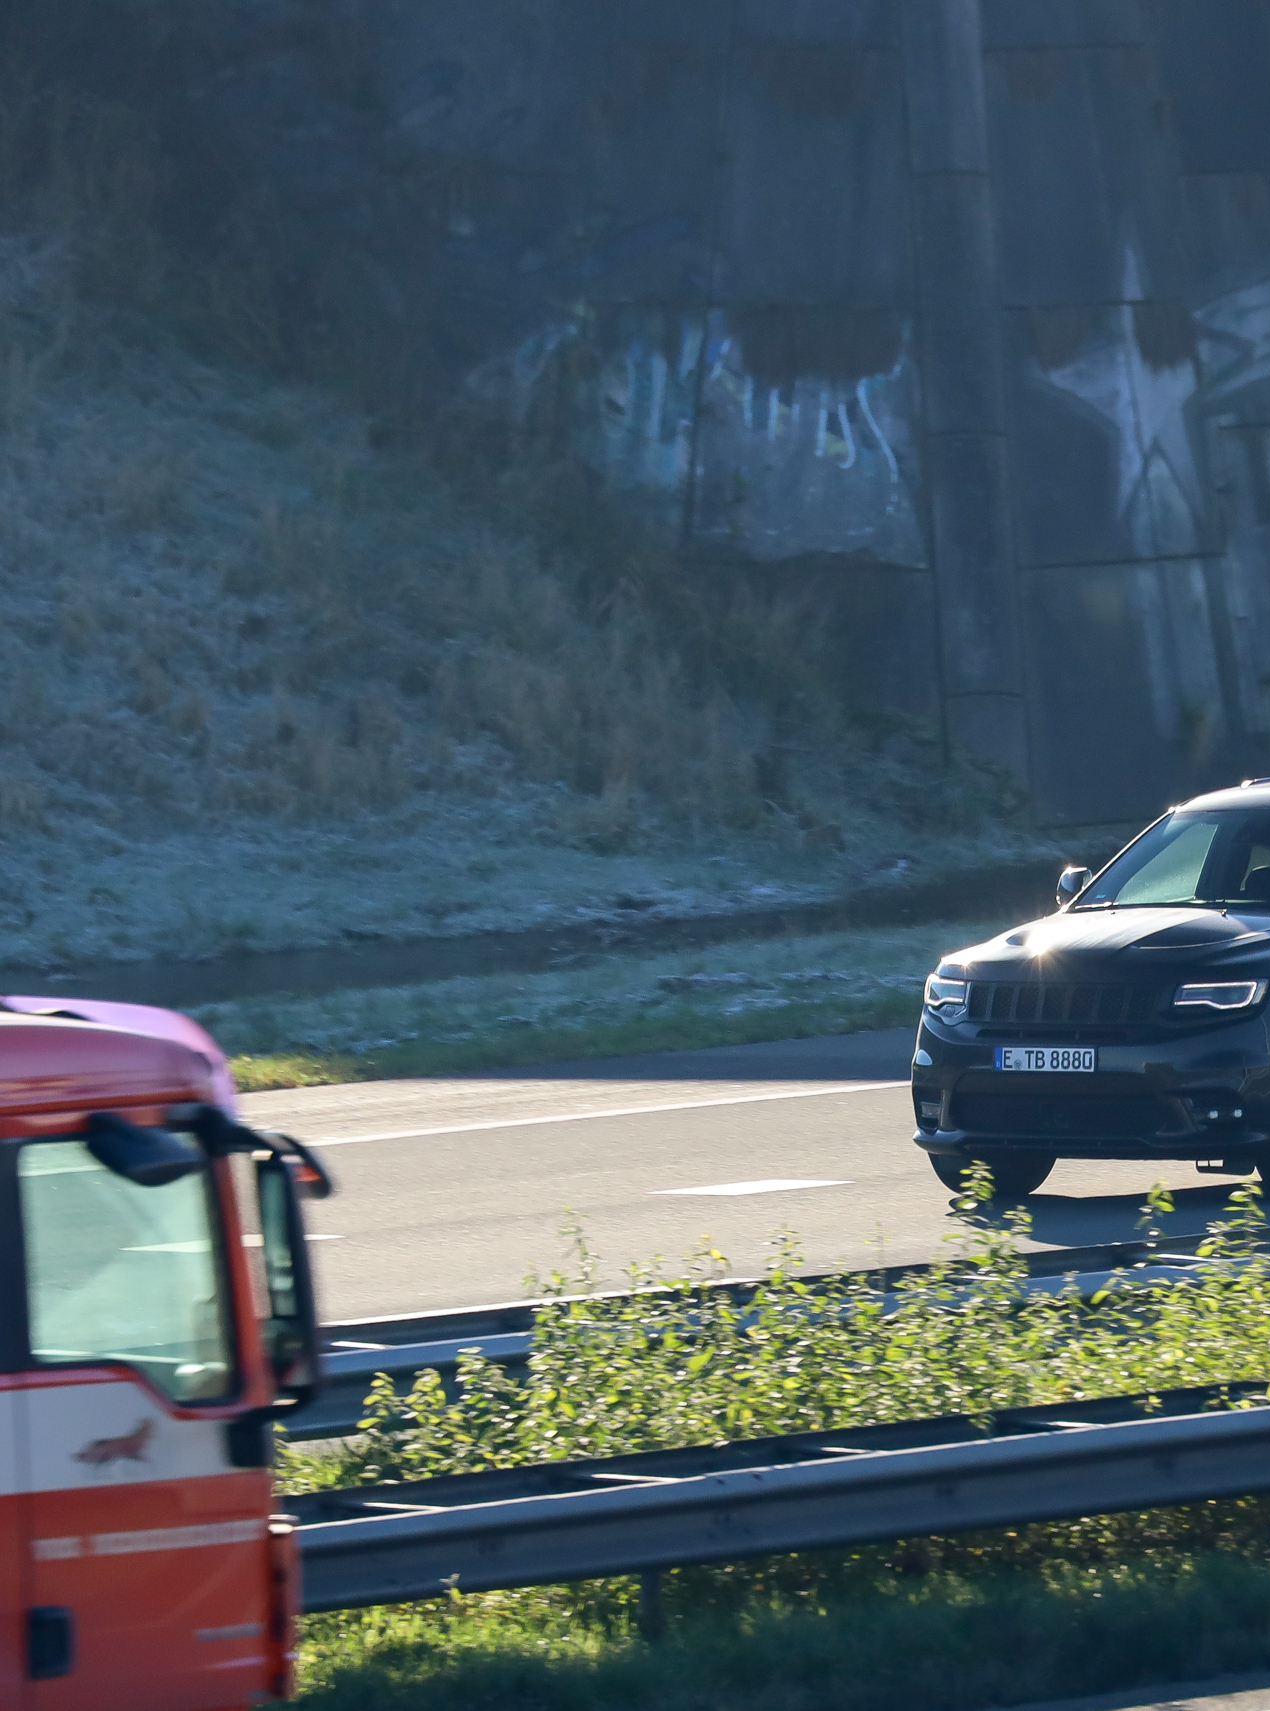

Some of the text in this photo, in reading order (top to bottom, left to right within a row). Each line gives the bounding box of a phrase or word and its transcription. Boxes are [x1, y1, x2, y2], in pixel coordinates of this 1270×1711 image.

[1003, 1050, 1093, 1070] E TB 8880
